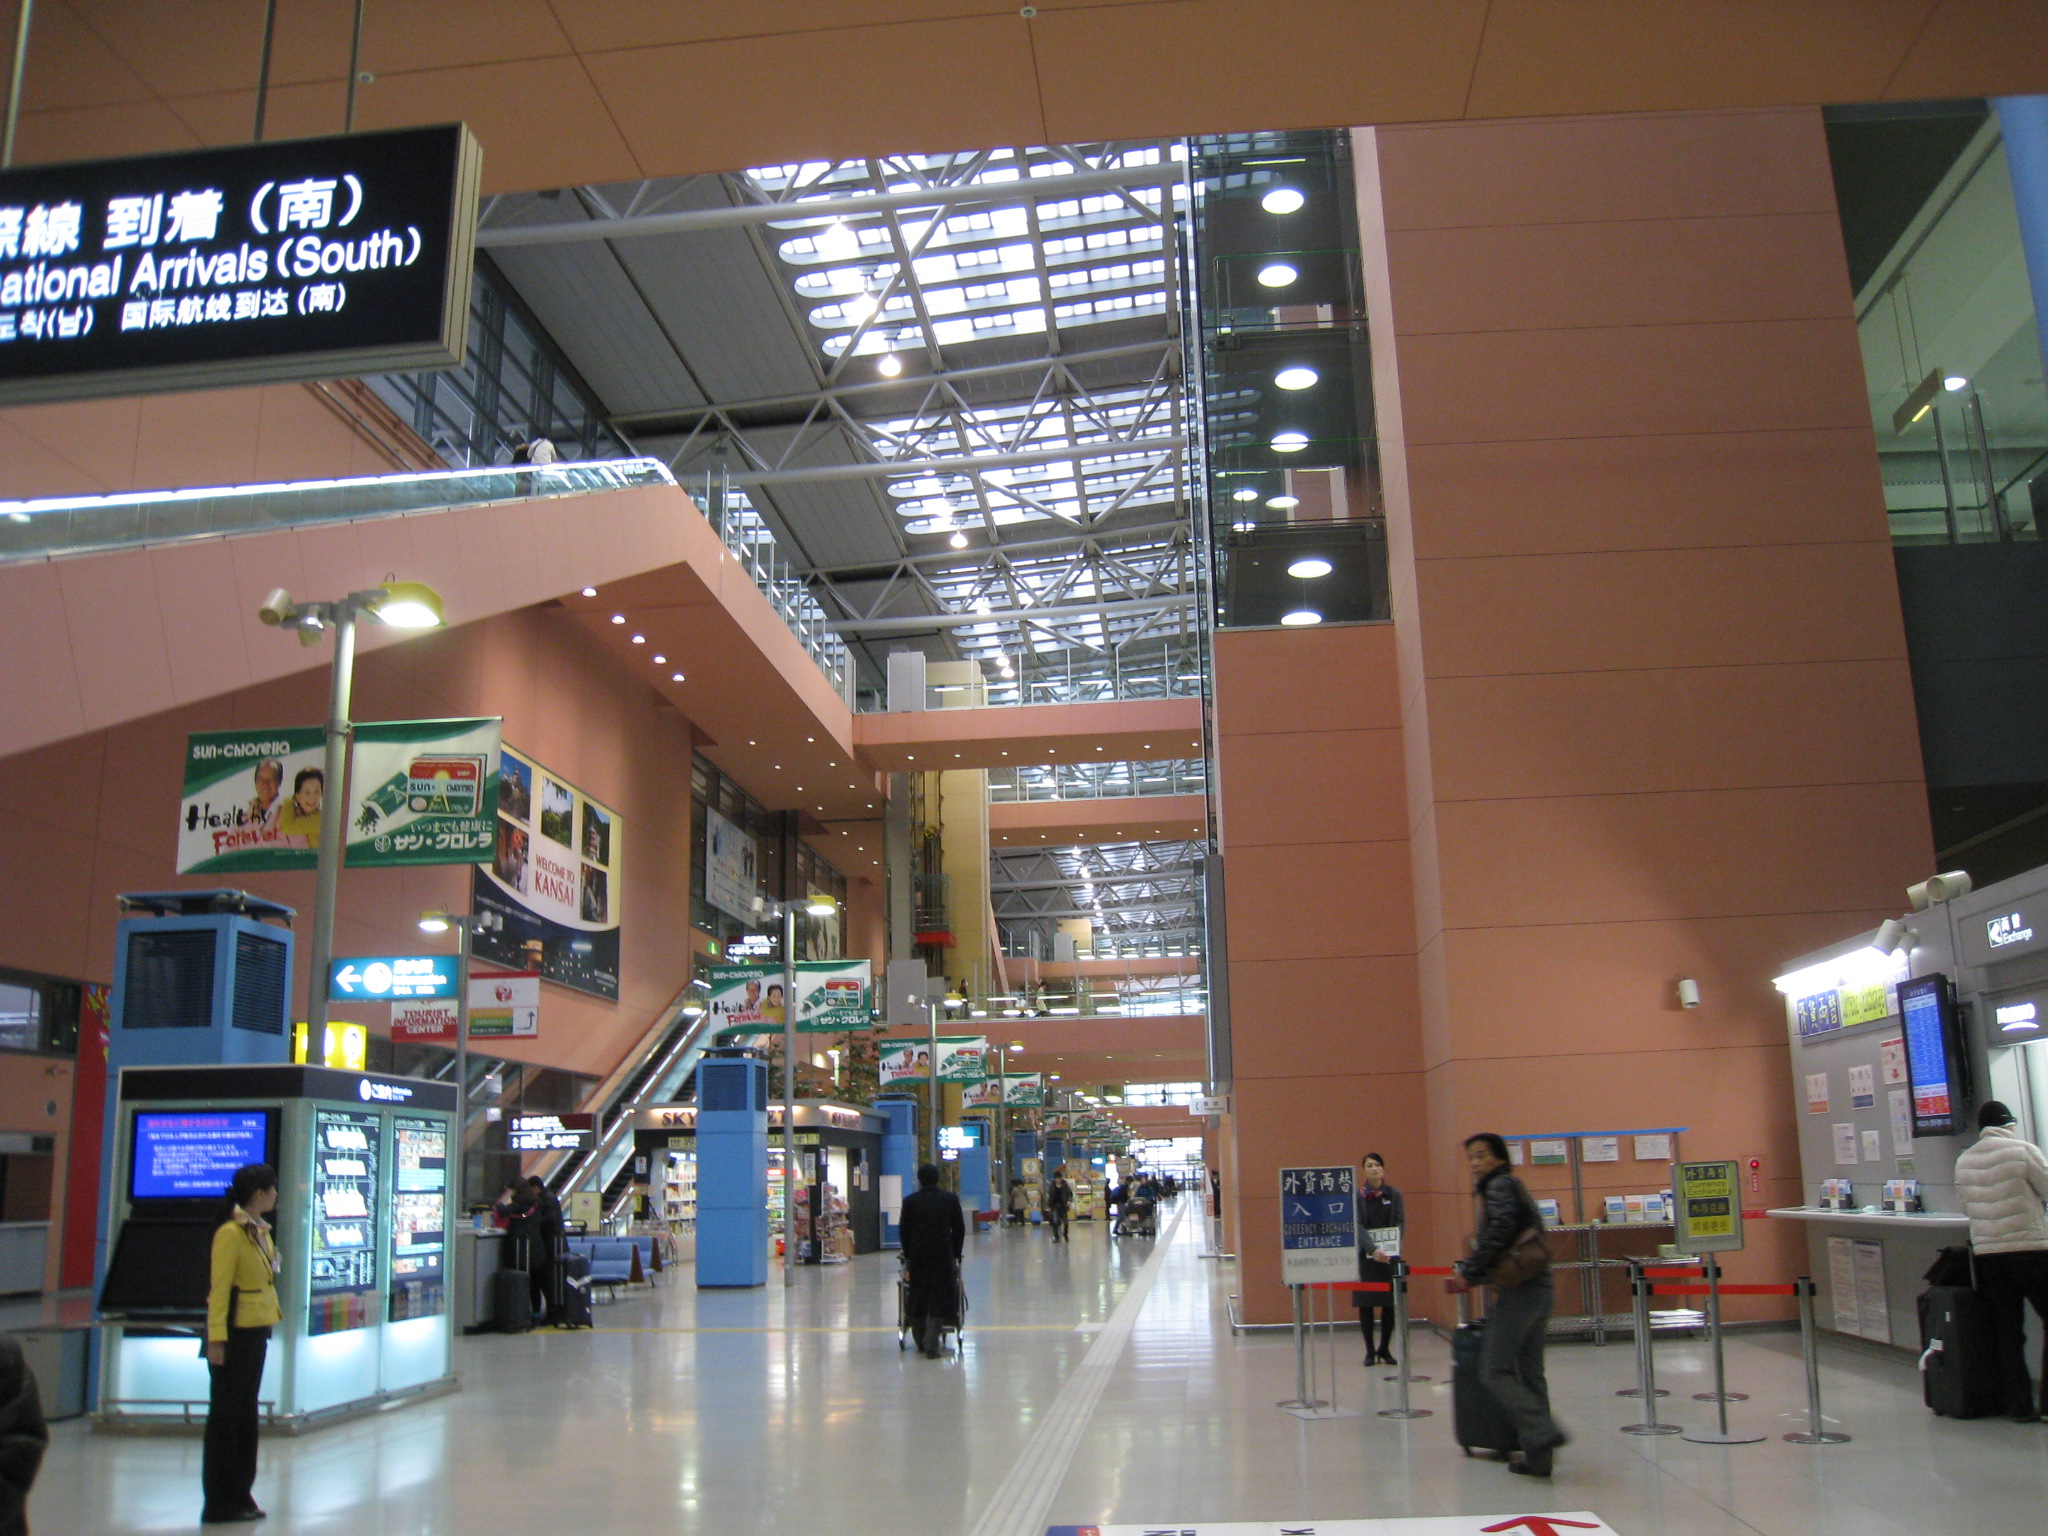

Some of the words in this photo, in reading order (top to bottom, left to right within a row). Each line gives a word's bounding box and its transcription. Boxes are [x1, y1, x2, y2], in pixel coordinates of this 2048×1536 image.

[103, 188, 223, 250] 到着
[0, 254, 122, 307] ational
[129, 240, 268, 293] Arrivals
[277, 227, 421, 279] (South)
[394, 832, 493, 851] サン・クロレラ
[535, 854, 566, 880] WELCOME
[565, 868, 575, 885] TO
[534, 871, 574, 908] KANSAI
[2002, 927, 2034, 944] Exchange
[393, 1016, 457, 1027] INFORMATION
[402, 1008, 450, 1019] TOURIST
[405, 1025, 445, 1034] CENTER
[661, 1111, 697, 1127] SKY
[1283, 1170, 1353, 1195] 外貨両替
[1687, 1181, 1727, 1189] Currency
[1283, 1222, 1318, 1235] CURRENCY
[1321, 1221, 1354, 1234] EXCHANGE
[1297, 1235, 1342, 1248] ENTRANCE
